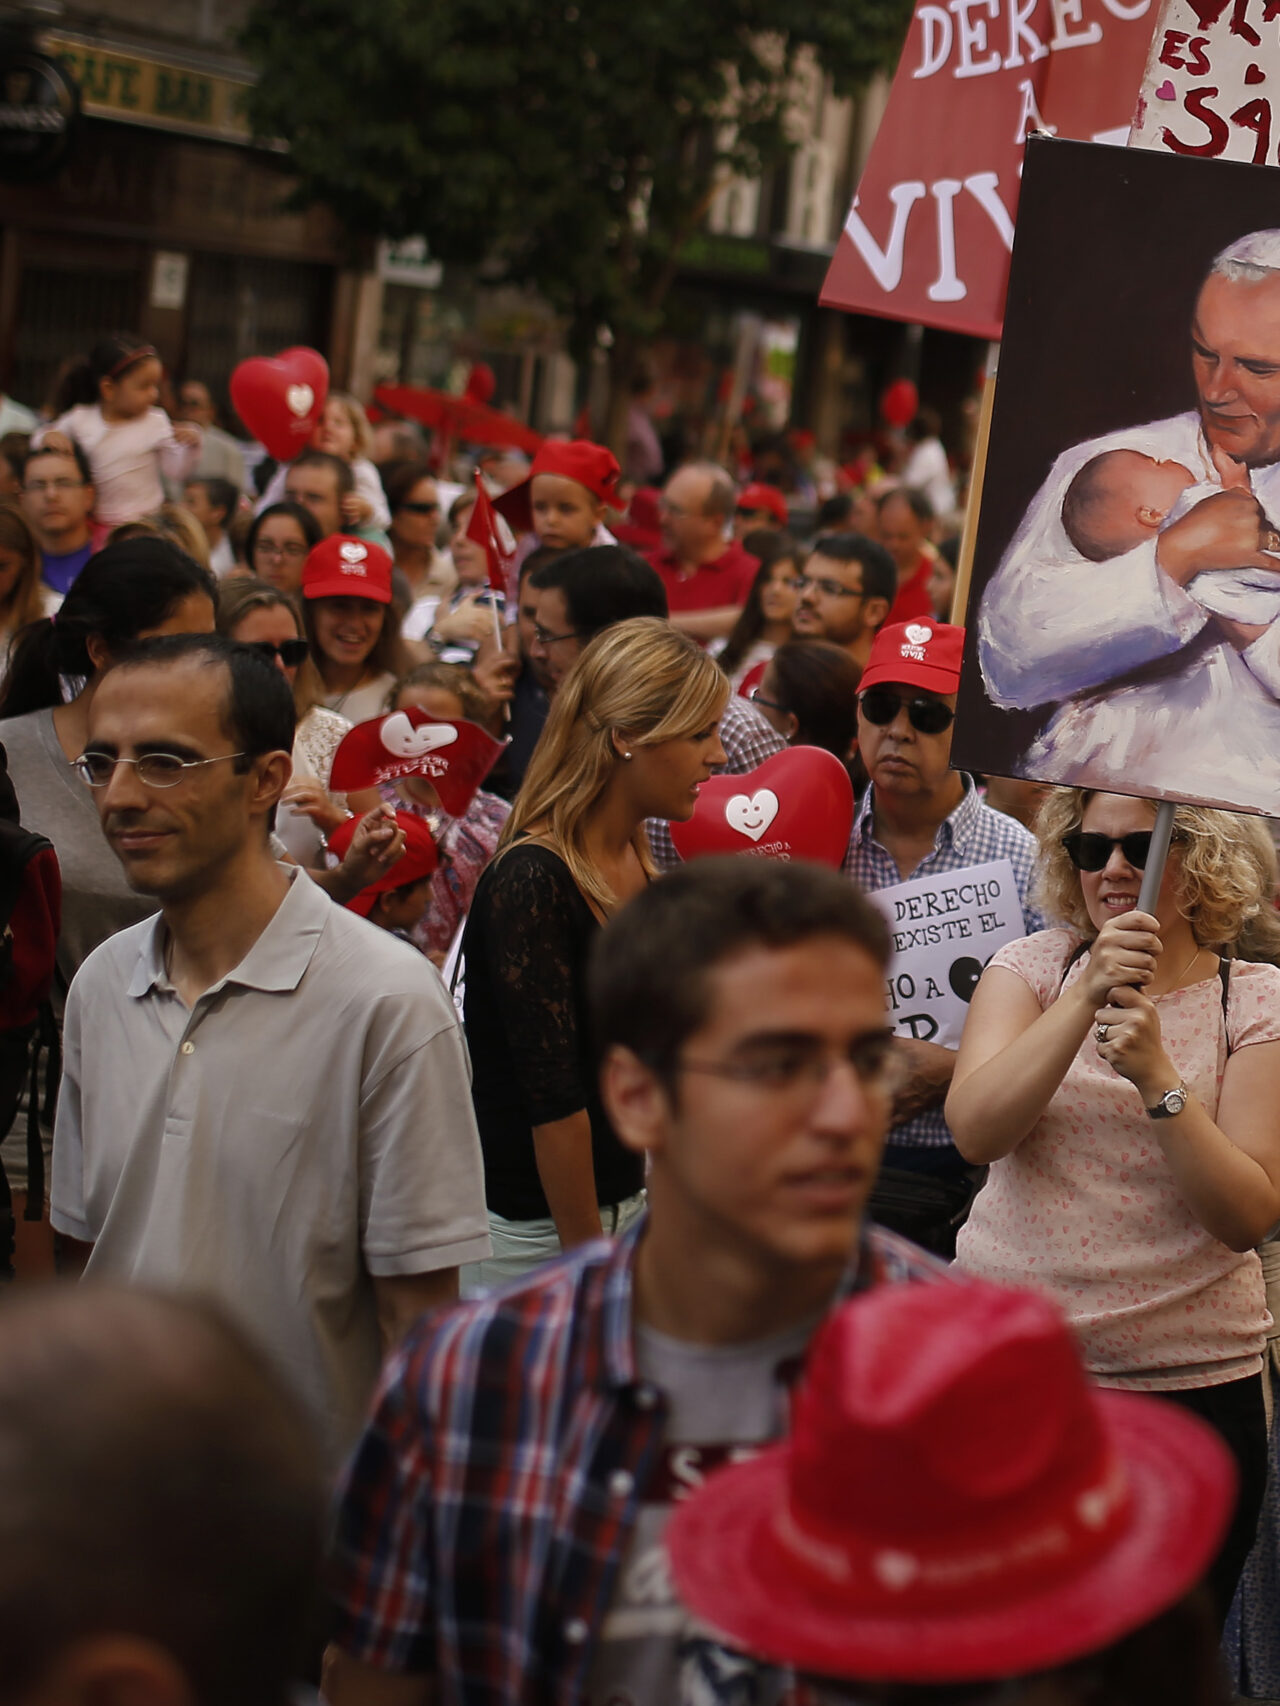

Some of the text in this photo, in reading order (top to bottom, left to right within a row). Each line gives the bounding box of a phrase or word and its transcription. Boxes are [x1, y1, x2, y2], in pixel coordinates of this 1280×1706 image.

[1159, 29, 1211, 76] ES
[894, 879, 1001, 922] DERECHO
[893, 911, 1006, 953] EXISTE EL
